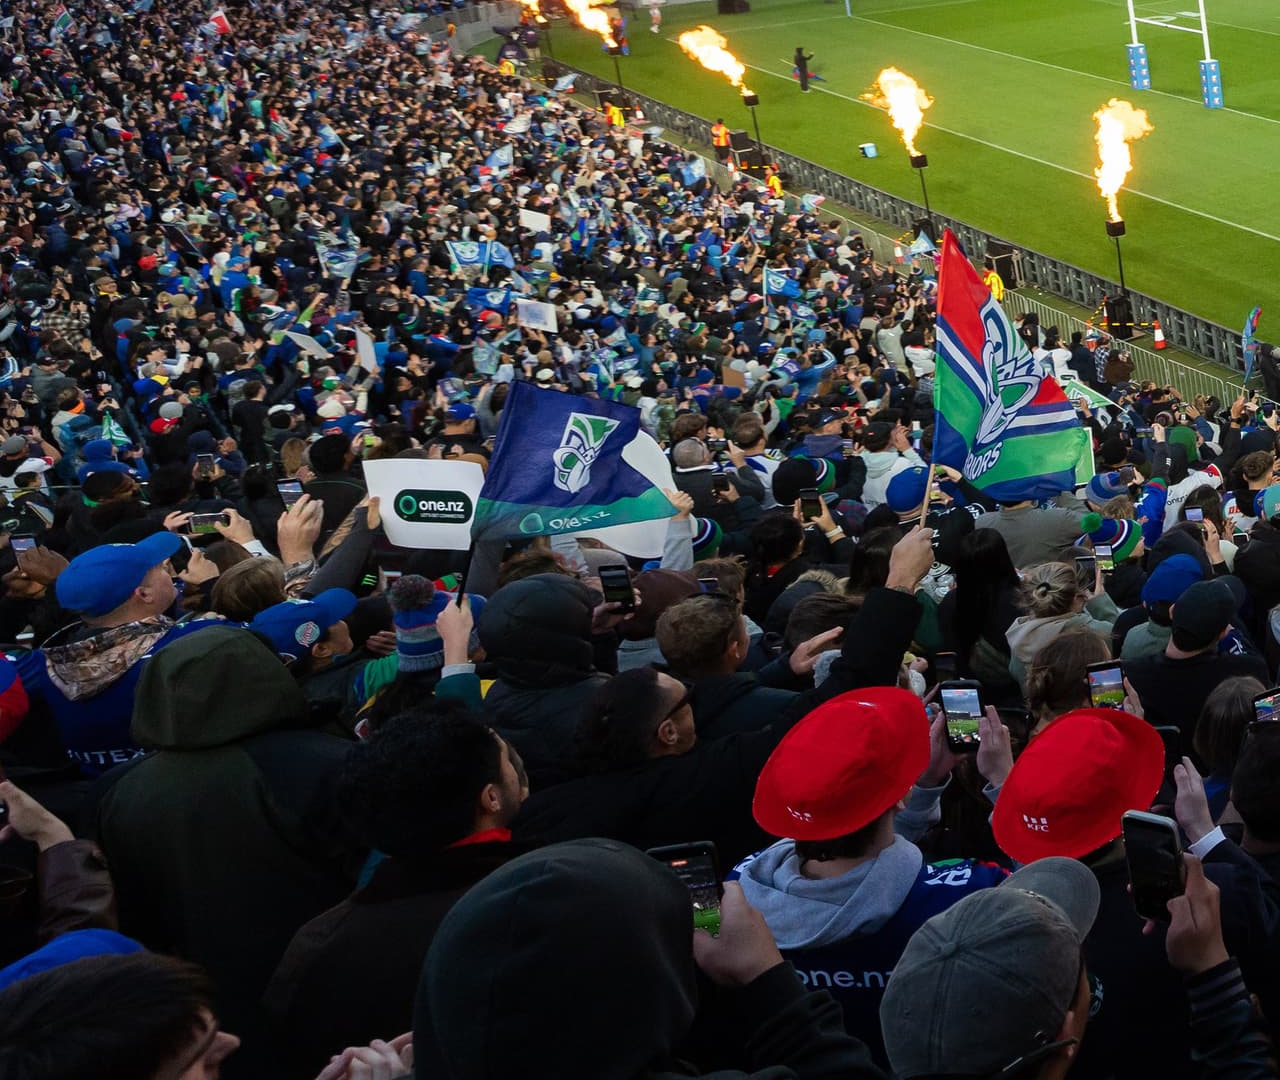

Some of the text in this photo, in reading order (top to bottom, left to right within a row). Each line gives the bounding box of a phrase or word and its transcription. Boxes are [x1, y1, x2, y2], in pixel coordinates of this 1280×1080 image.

[964, 441, 1003, 481] RIORS
[419, 500, 465, 513] one.nz
[549, 510, 612, 529] one.nz
[1027, 823, 1050, 832] KFC
